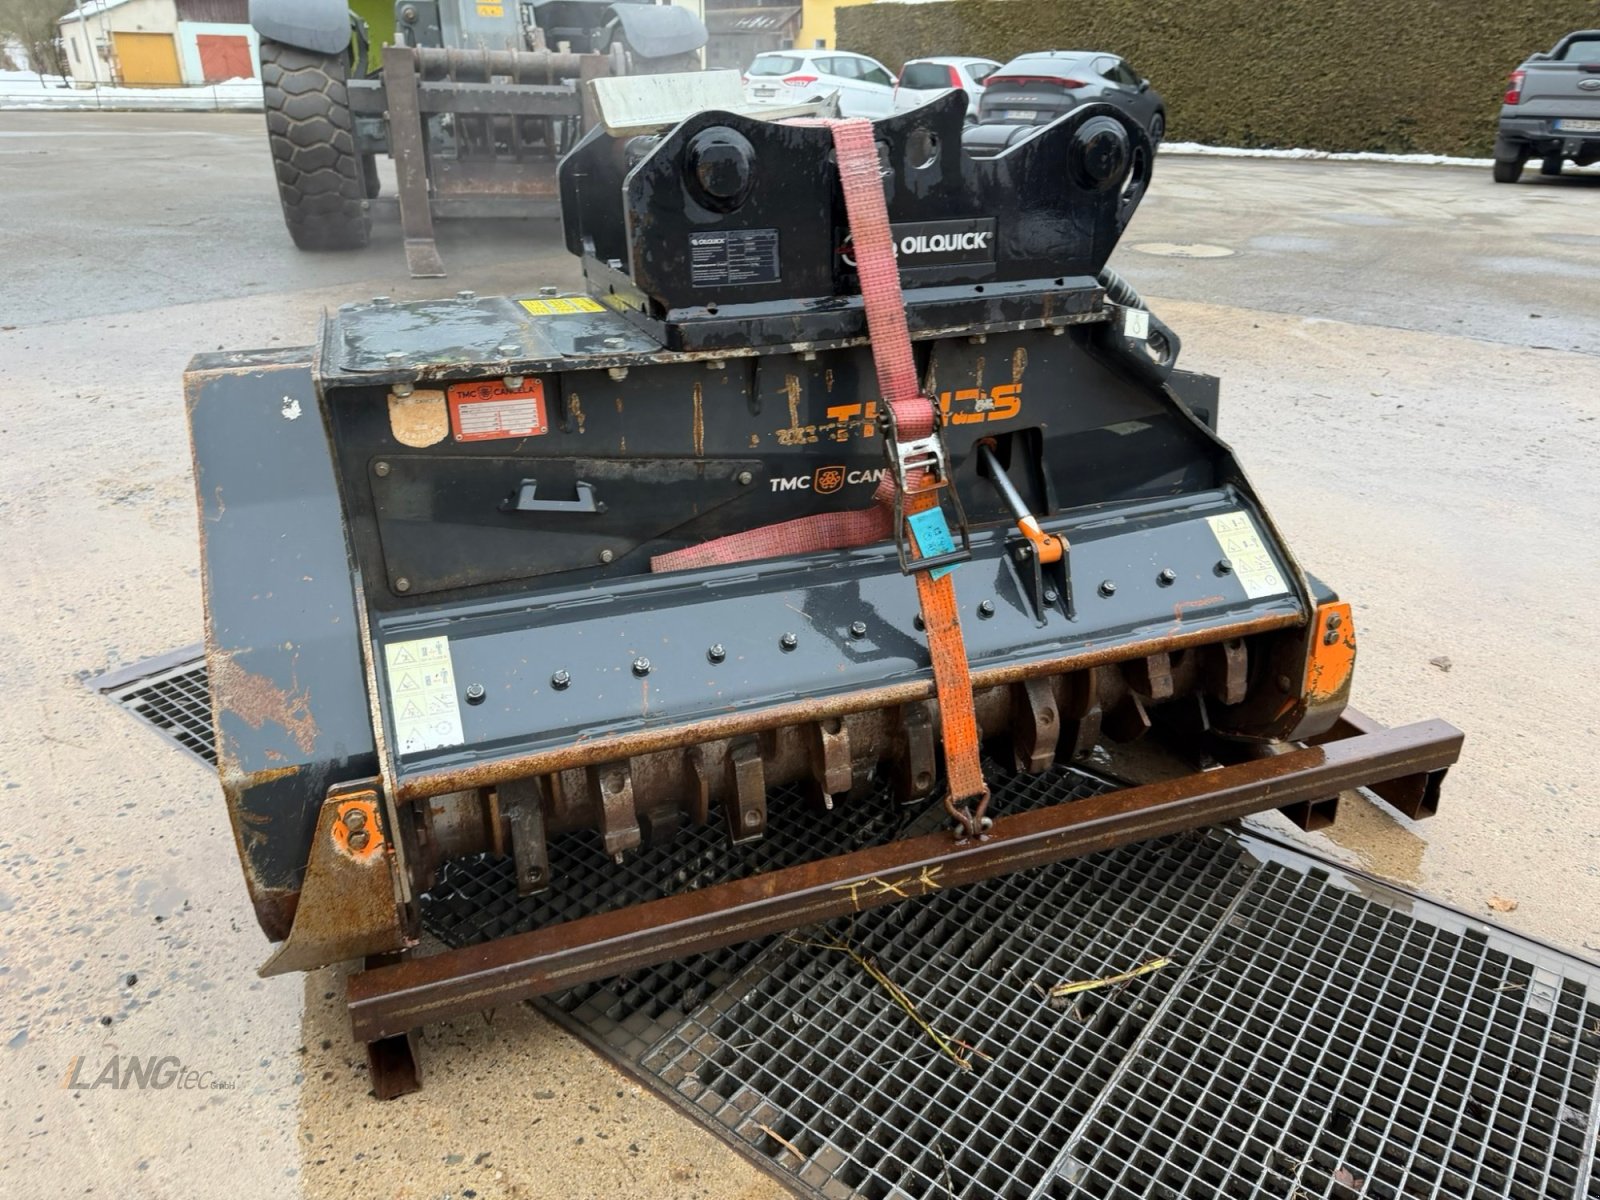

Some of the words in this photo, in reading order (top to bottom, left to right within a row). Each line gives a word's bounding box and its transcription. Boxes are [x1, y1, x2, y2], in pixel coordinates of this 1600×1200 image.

[456, 390, 477, 399] TMC
[493, 386, 535, 396] CAELA
[769, 475, 812, 492] TMC
[847, 468, 887, 485] CAN
